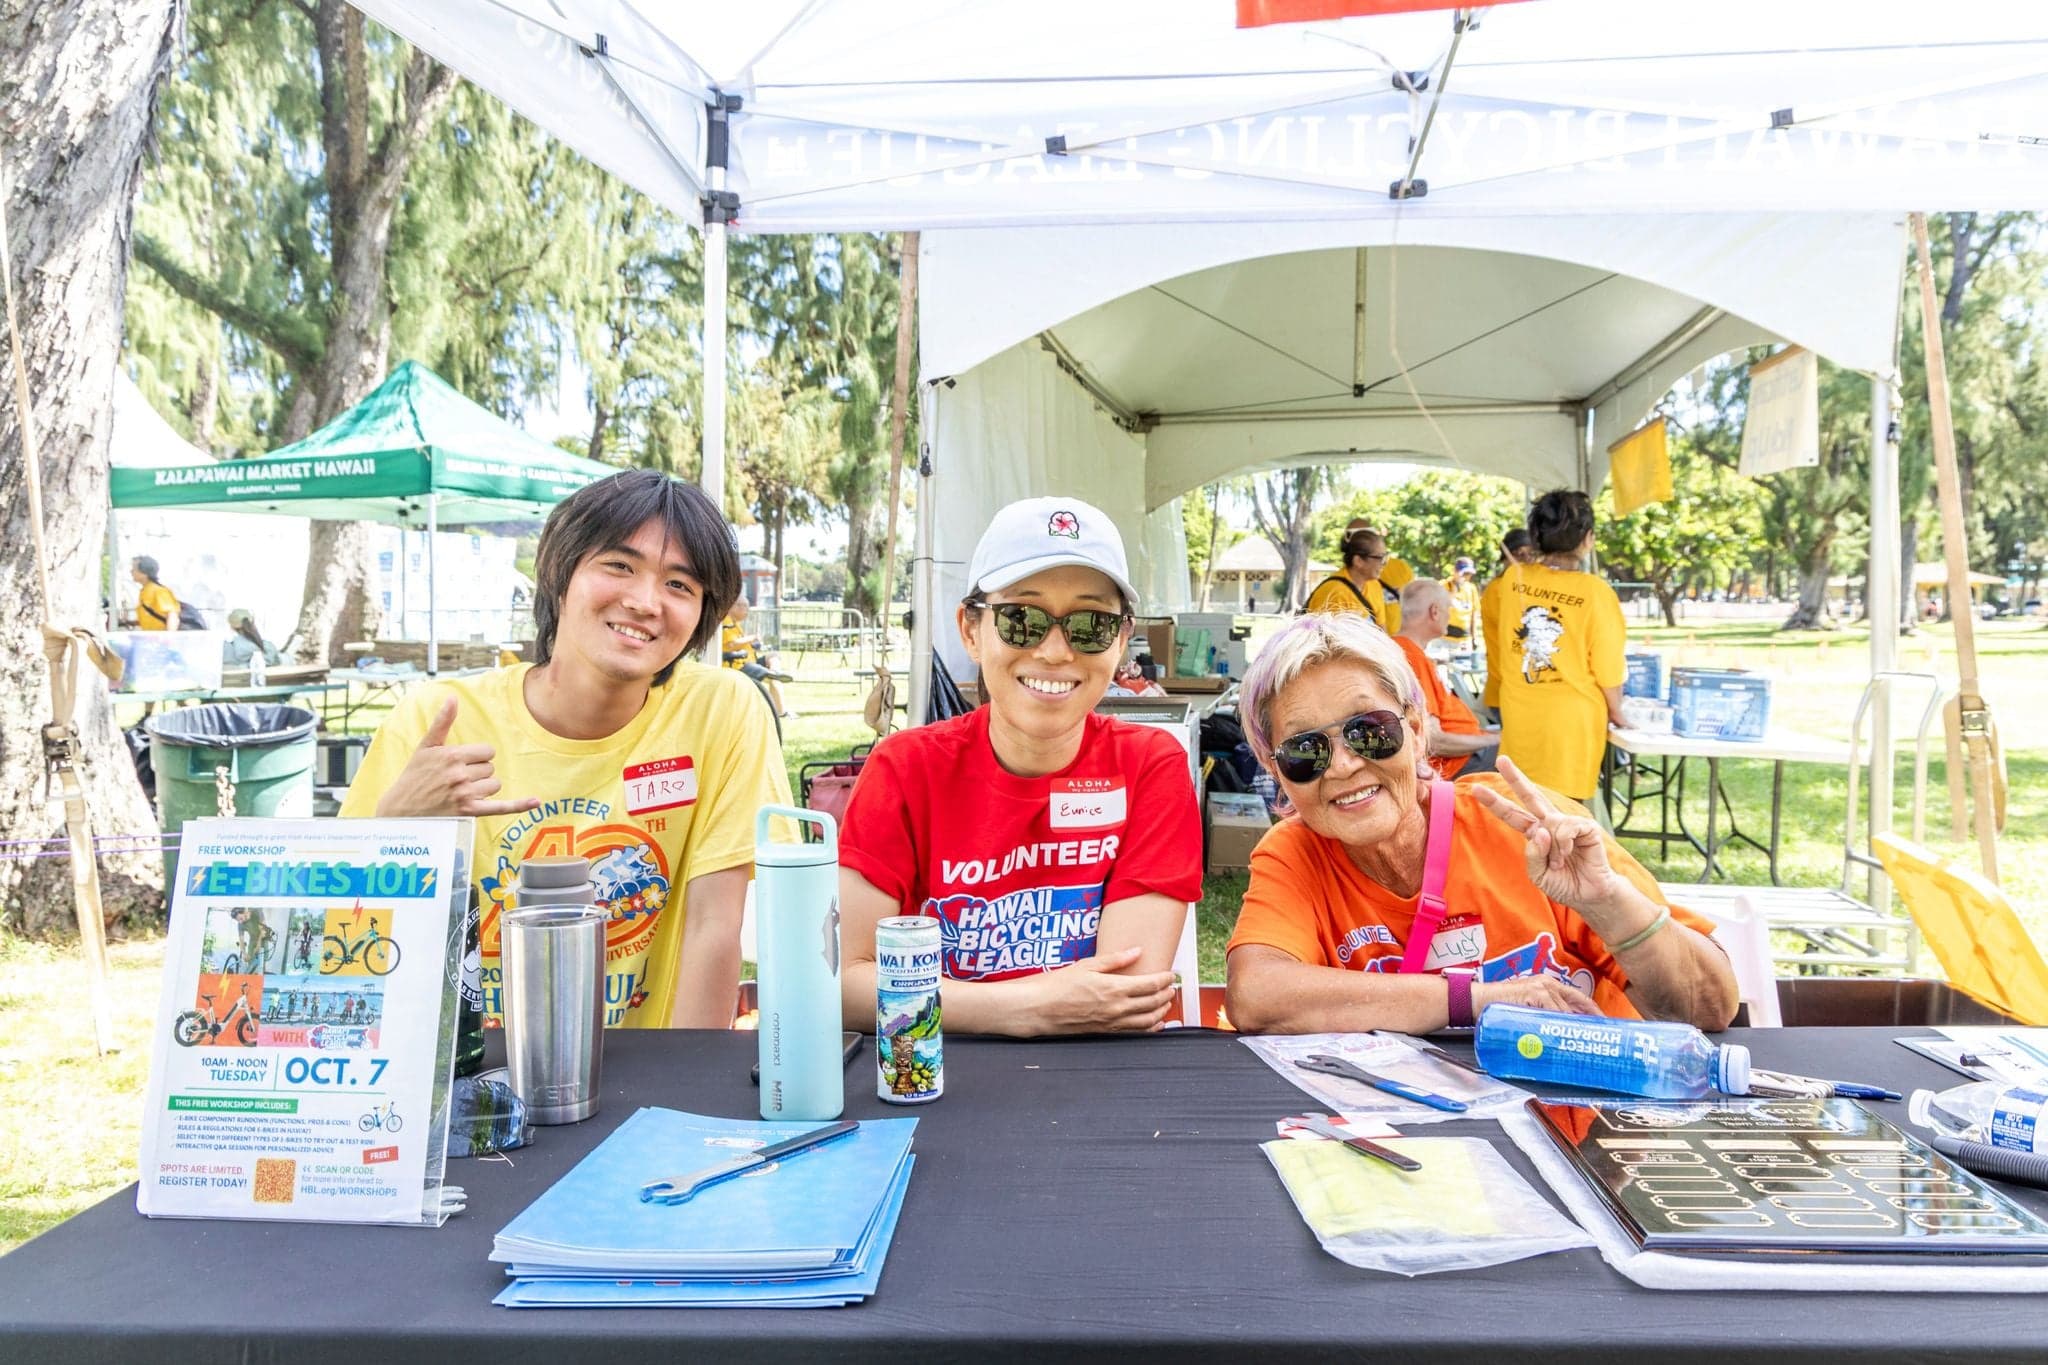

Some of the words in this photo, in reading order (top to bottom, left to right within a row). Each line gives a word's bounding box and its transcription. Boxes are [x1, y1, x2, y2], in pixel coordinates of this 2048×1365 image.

[155, 467, 244, 485] KALAPAWAI
[246, 462, 312, 481] MARKET
[314, 458, 376, 477] HAWAII
[1511, 582, 1585, 608] VOLUNTEER
[638, 759, 678, 773] ALOHA
[1067, 779, 1112, 788] ALOHA
[632, 779, 686, 803] TARO
[1060, 802, 1103, 817] Eunice
[500, 797, 611, 852] VOLUNTEER
[644, 817, 667, 834] TH
[198, 845, 222, 856] FREE
[223, 845, 286, 856] WORKSHOP
[379, 844, 430, 856] @MĀNOA
[941, 835, 1120, 885] VOLUNTEER
[208, 861, 352, 895] E-BIKES
[362, 861, 419, 896] 101
[957, 888, 1053, 930] HAWAII
[1440, 915, 1466, 925] OHA
[958, 910, 1100, 951] BICYCLING
[879, 952, 906, 968] WAI
[912, 950, 941, 968] KOK
[958, 939, 1064, 973] LEAGUE
[893, 977, 937, 987] ORIGINAL
[272, 1031, 305, 1043] WITH
[772, 1012, 781, 1067] cotopaxi
[1539, 1023, 1622, 1044] HYDRATION
[1557, 1037, 1620, 1057] PERFECT
[202, 1057, 228, 1067] 10AM
[236, 1058, 268, 1068] NOON
[210, 1069, 267, 1082] TUESDAY
[285, 1057, 357, 1085] OCT.
[368, 1059, 390, 1086] 7
[175, 1098, 191, 1107] THIS
[191, 1098, 209, 1108] FREE
[210, 1099, 254, 1109] WORKSHOP
[213, 1143, 227, 1151] Q&A
[267, 1145, 312, 1153] PERSONALIZED
[369, 1150, 390, 1160] FREE!
[160, 1164, 189, 1173] SPOTS
[189, 1165, 208, 1174] ARE
[315, 1165, 338, 1174] SCAN
[352, 1166, 375, 1175] CODE
[159, 1176, 208, 1186] REGISTER
[208, 1177, 248, 1188] TODAY!
[300, 1185, 398, 1197] HBL.org/WORKSHOPS
